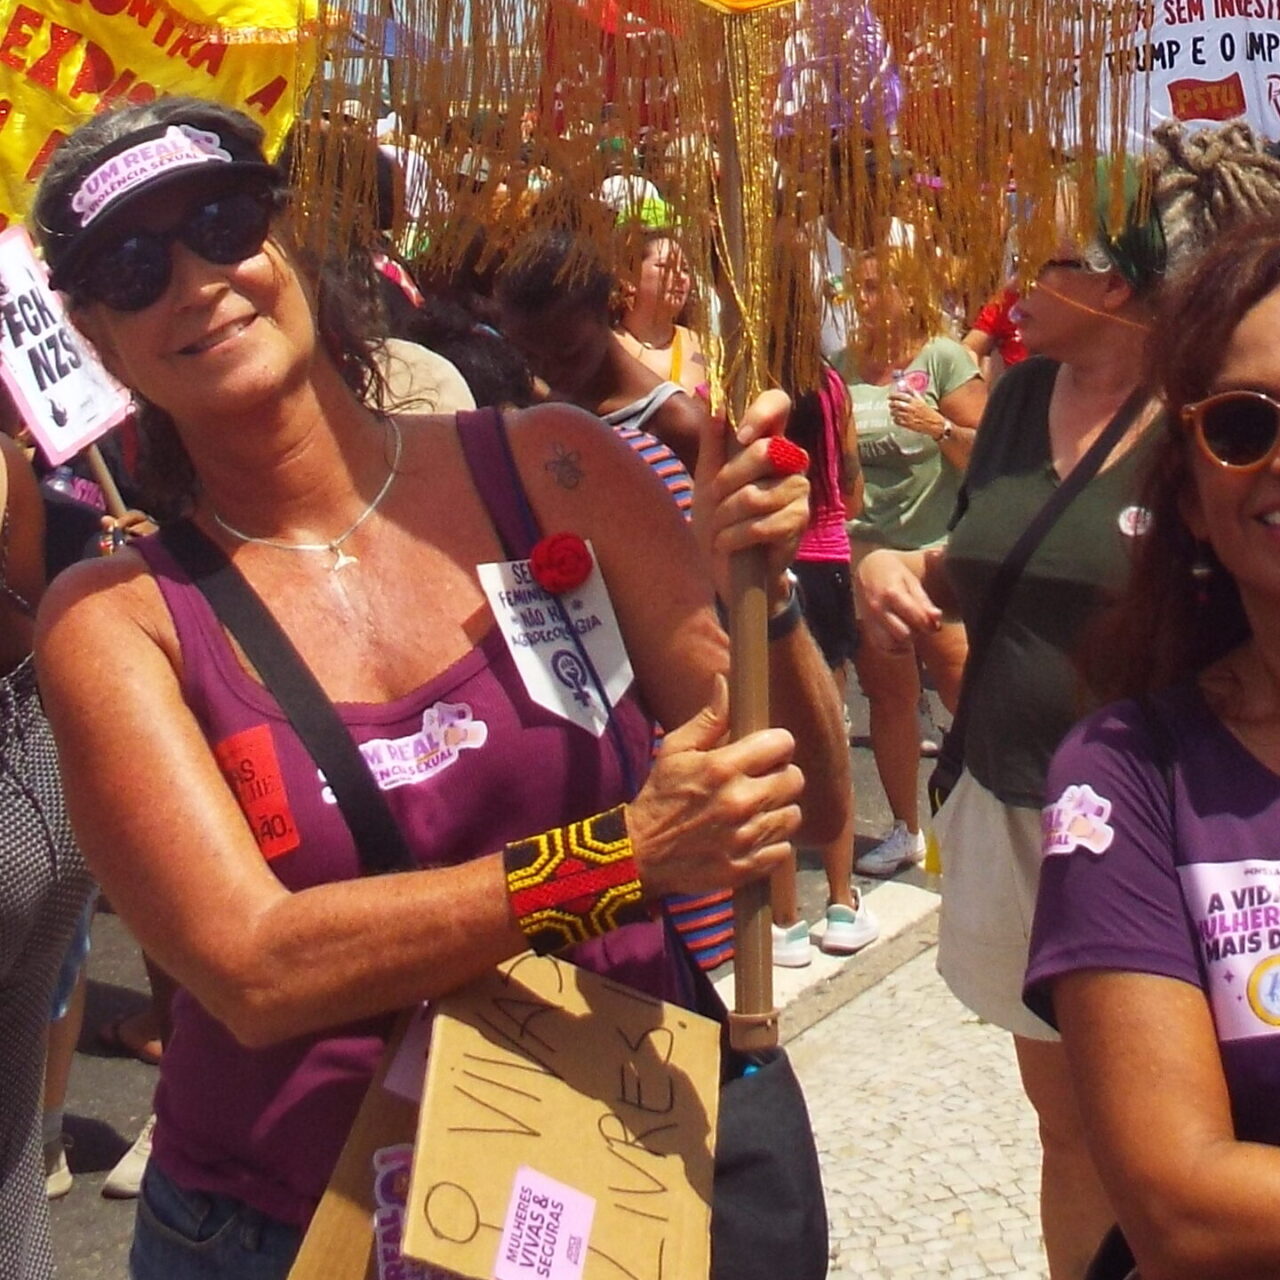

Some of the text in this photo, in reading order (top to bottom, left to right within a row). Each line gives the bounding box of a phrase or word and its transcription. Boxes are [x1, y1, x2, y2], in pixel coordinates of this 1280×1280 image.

[1192, 36, 1206, 65] E
[1220, 32, 1234, 61] O
[1176, 83, 1240, 113] PSTU
[85, 162, 120, 196] UM
[121, 139, 184, 169] REAL
[150, 152, 198, 169] SEXUAL
[4, 286, 57, 349] FCK
[27, 327, 82, 392] NZS
[511, 563, 534, 585] SE
[521, 607, 545, 628] NÃO
[1208, 893, 1224, 914] A
[1205, 929, 1262, 963] MAIS
[506, 1186, 532, 1263] MULHERES
[520, 1211, 545, 1267] VIVAS
[537, 1199, 564, 1278] SEGURAS
